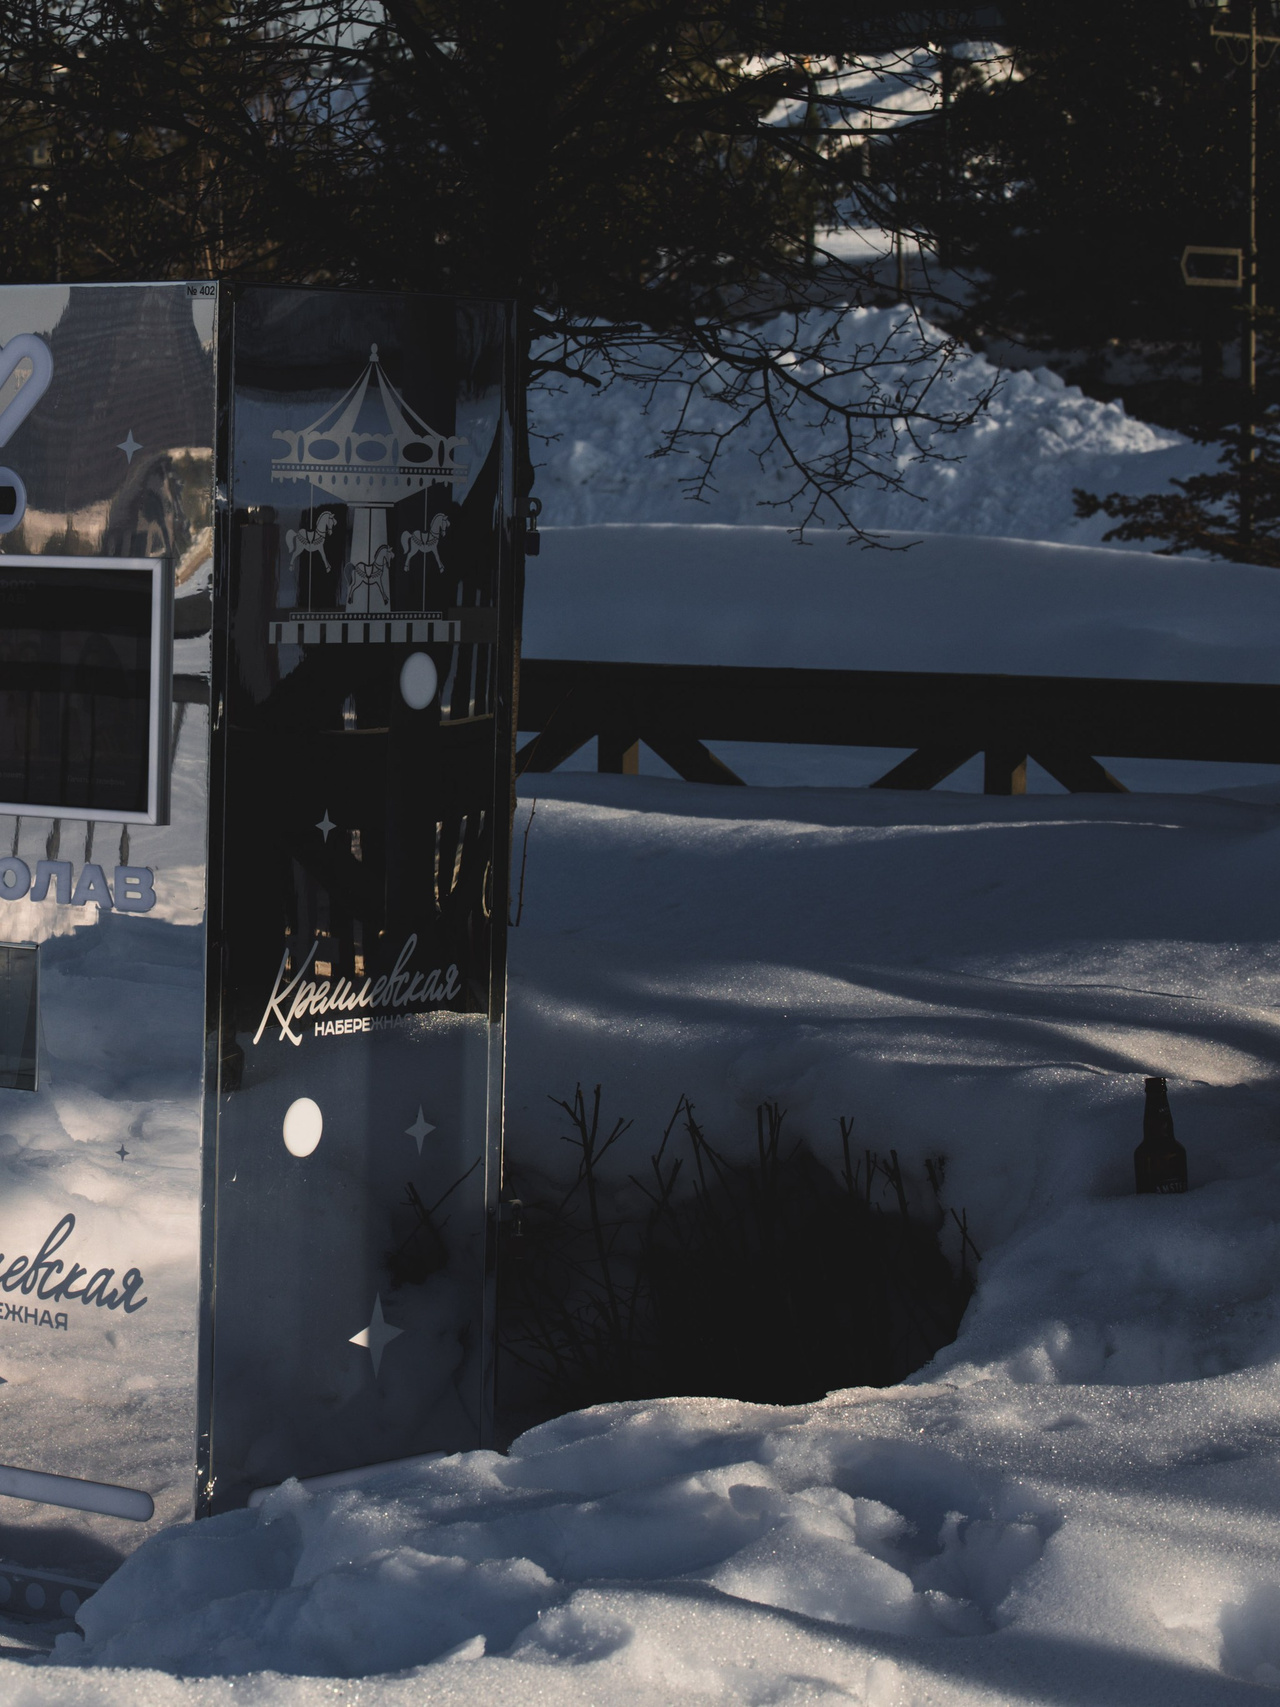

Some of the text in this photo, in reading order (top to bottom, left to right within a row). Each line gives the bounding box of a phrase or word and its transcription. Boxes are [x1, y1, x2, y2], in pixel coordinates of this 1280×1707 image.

[199, 285, 215, 296] 402
[252, 932, 462, 1047] Кремлевская
[314, 1012, 413, 1037] НАБЕРЕЖНАЯ
